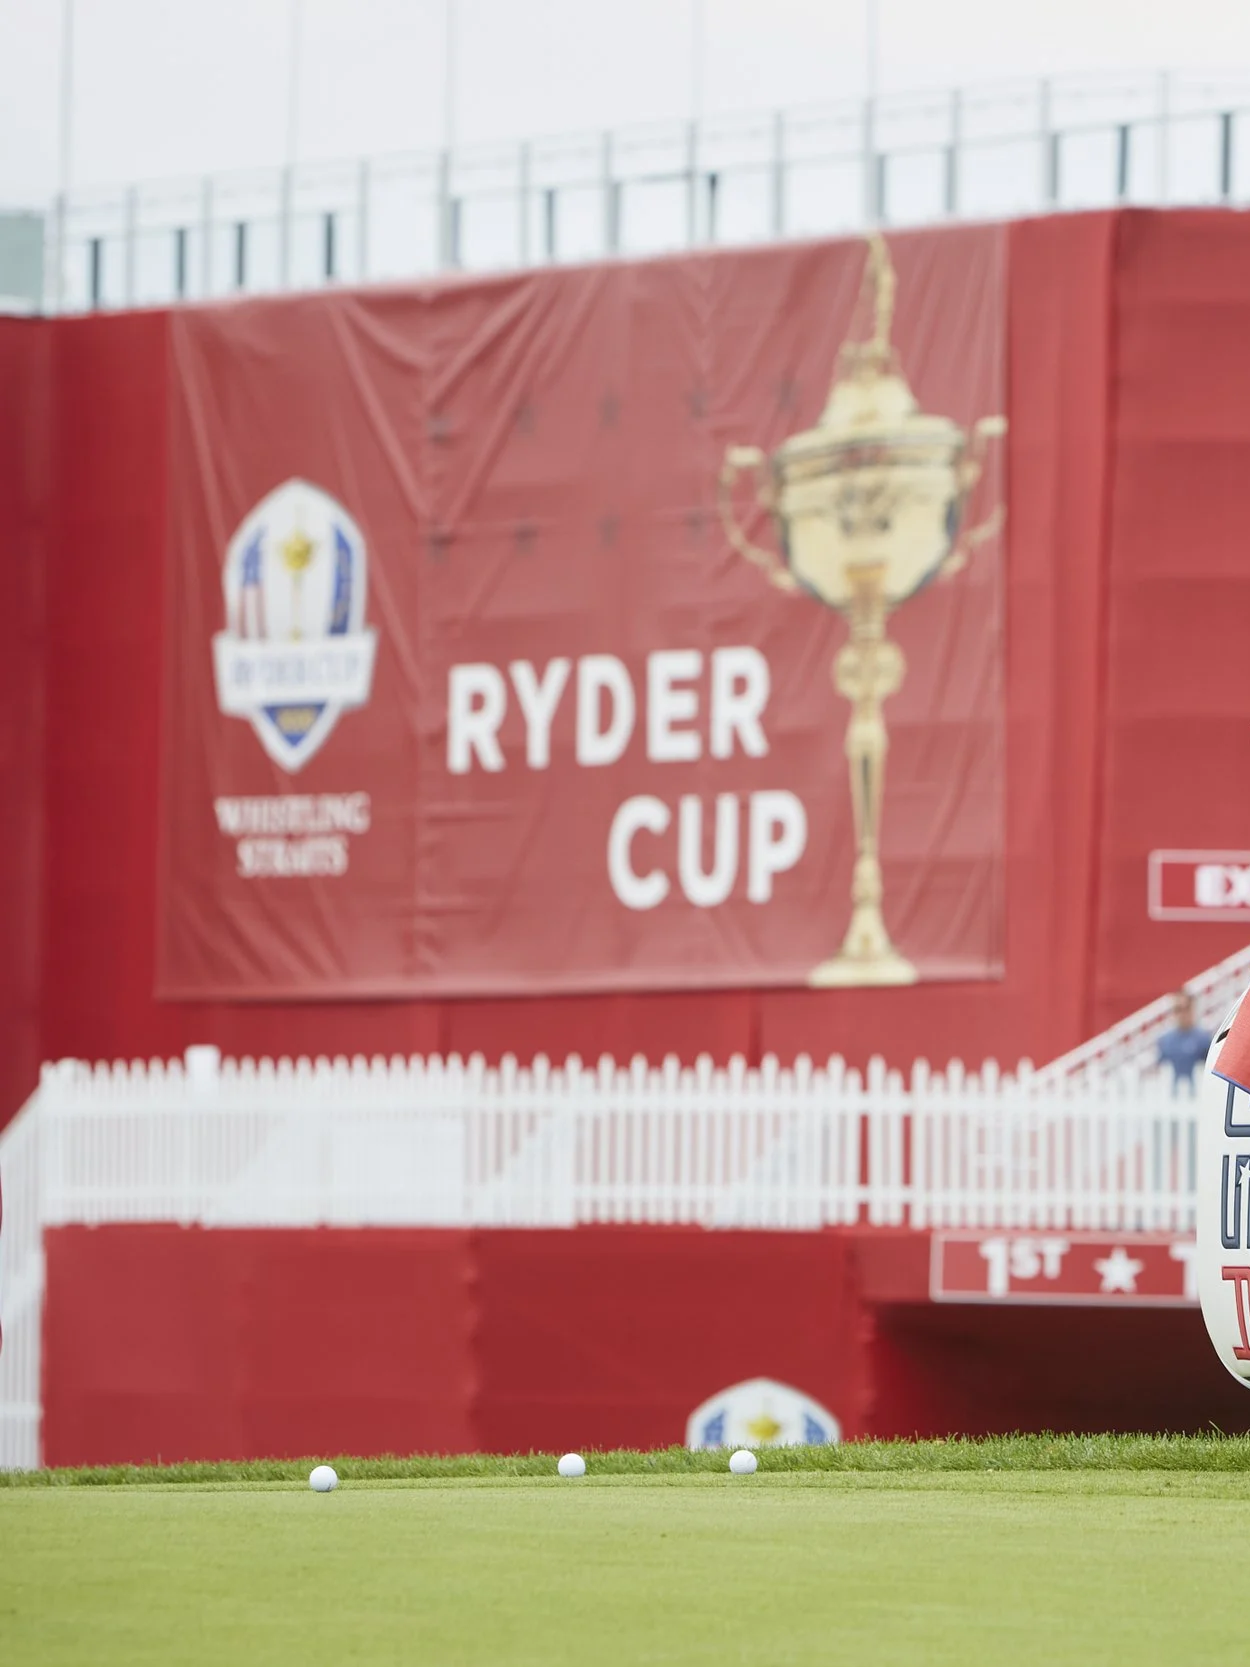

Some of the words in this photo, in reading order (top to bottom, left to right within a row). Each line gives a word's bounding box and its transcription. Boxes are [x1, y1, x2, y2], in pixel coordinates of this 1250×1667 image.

[446, 646, 769, 775] RYDER
[607, 790, 807, 911] CUP
[979, 1238, 1070, 1298] 1ST
